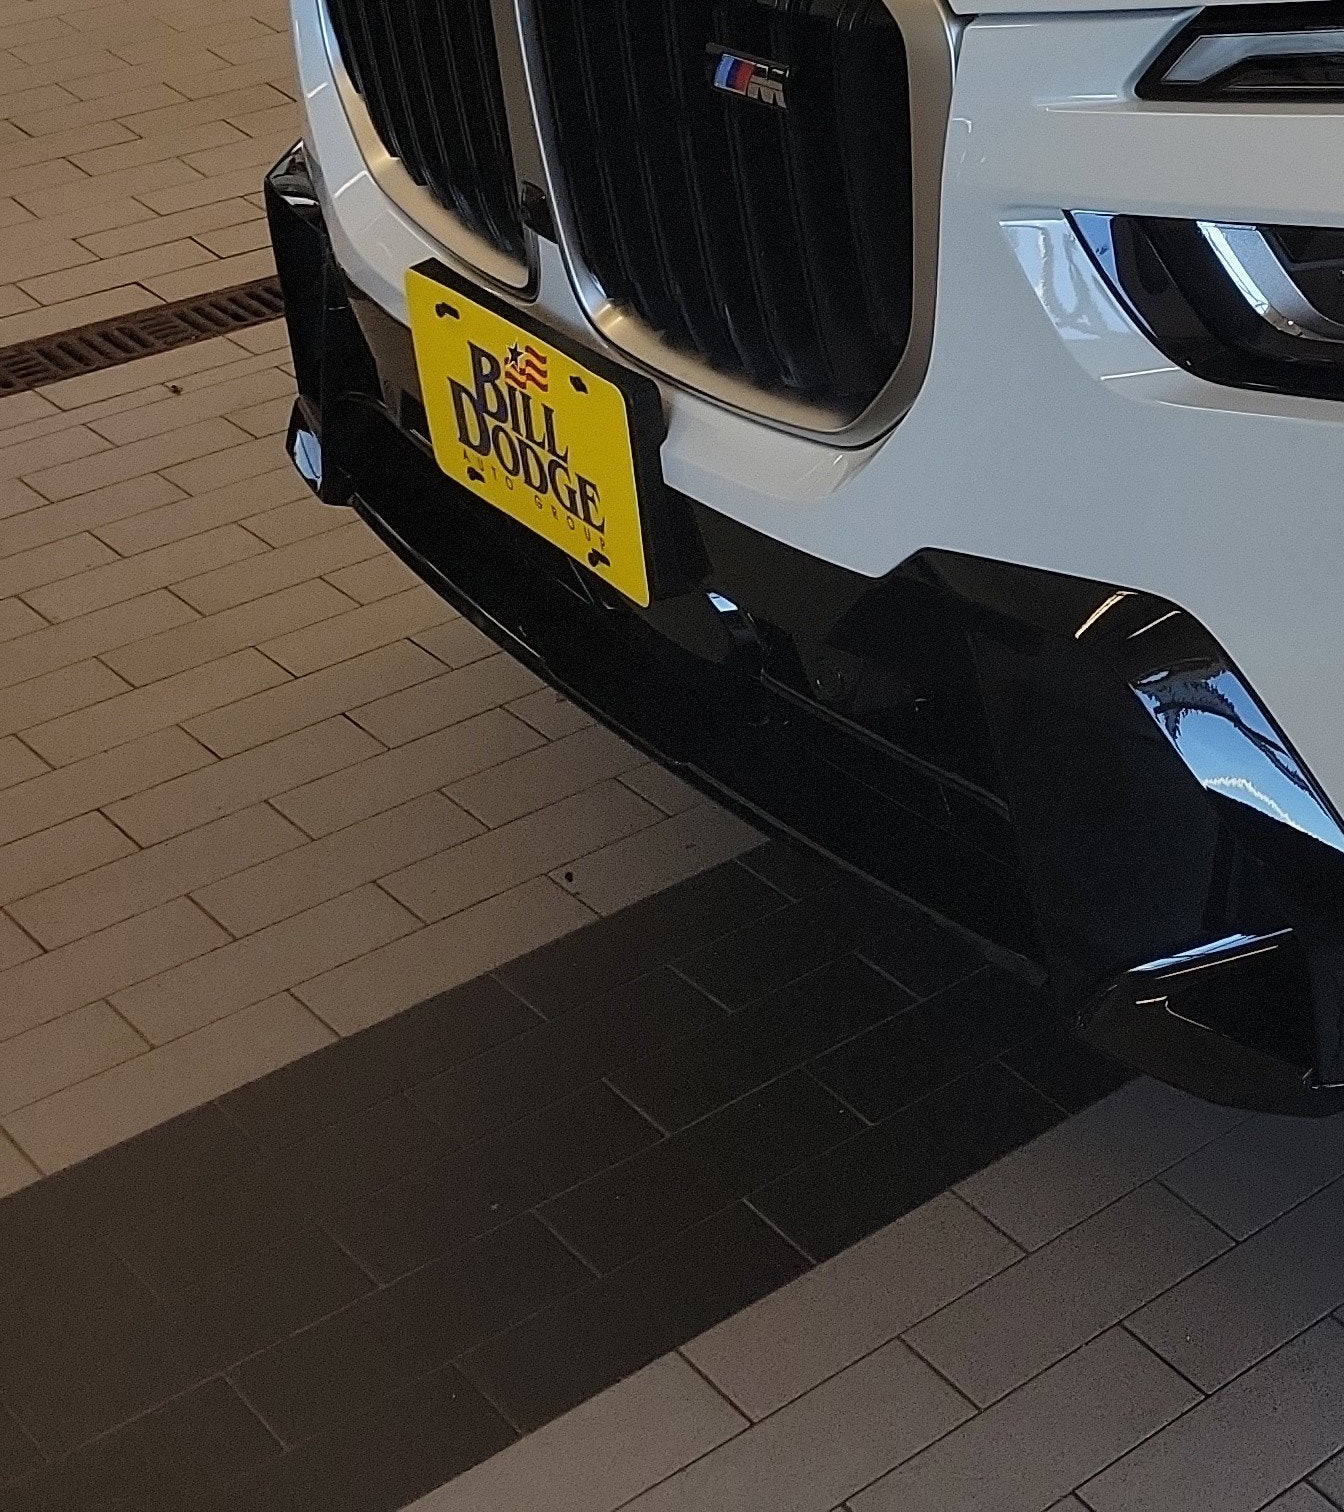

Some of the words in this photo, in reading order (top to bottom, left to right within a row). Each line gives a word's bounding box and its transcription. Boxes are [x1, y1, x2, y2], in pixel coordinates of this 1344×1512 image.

[446, 376, 606, 536] DODGE
[466, 340, 569, 466] BILL
[463, 448, 514, 491] AUTO
[534, 494, 606, 552] GROUP
